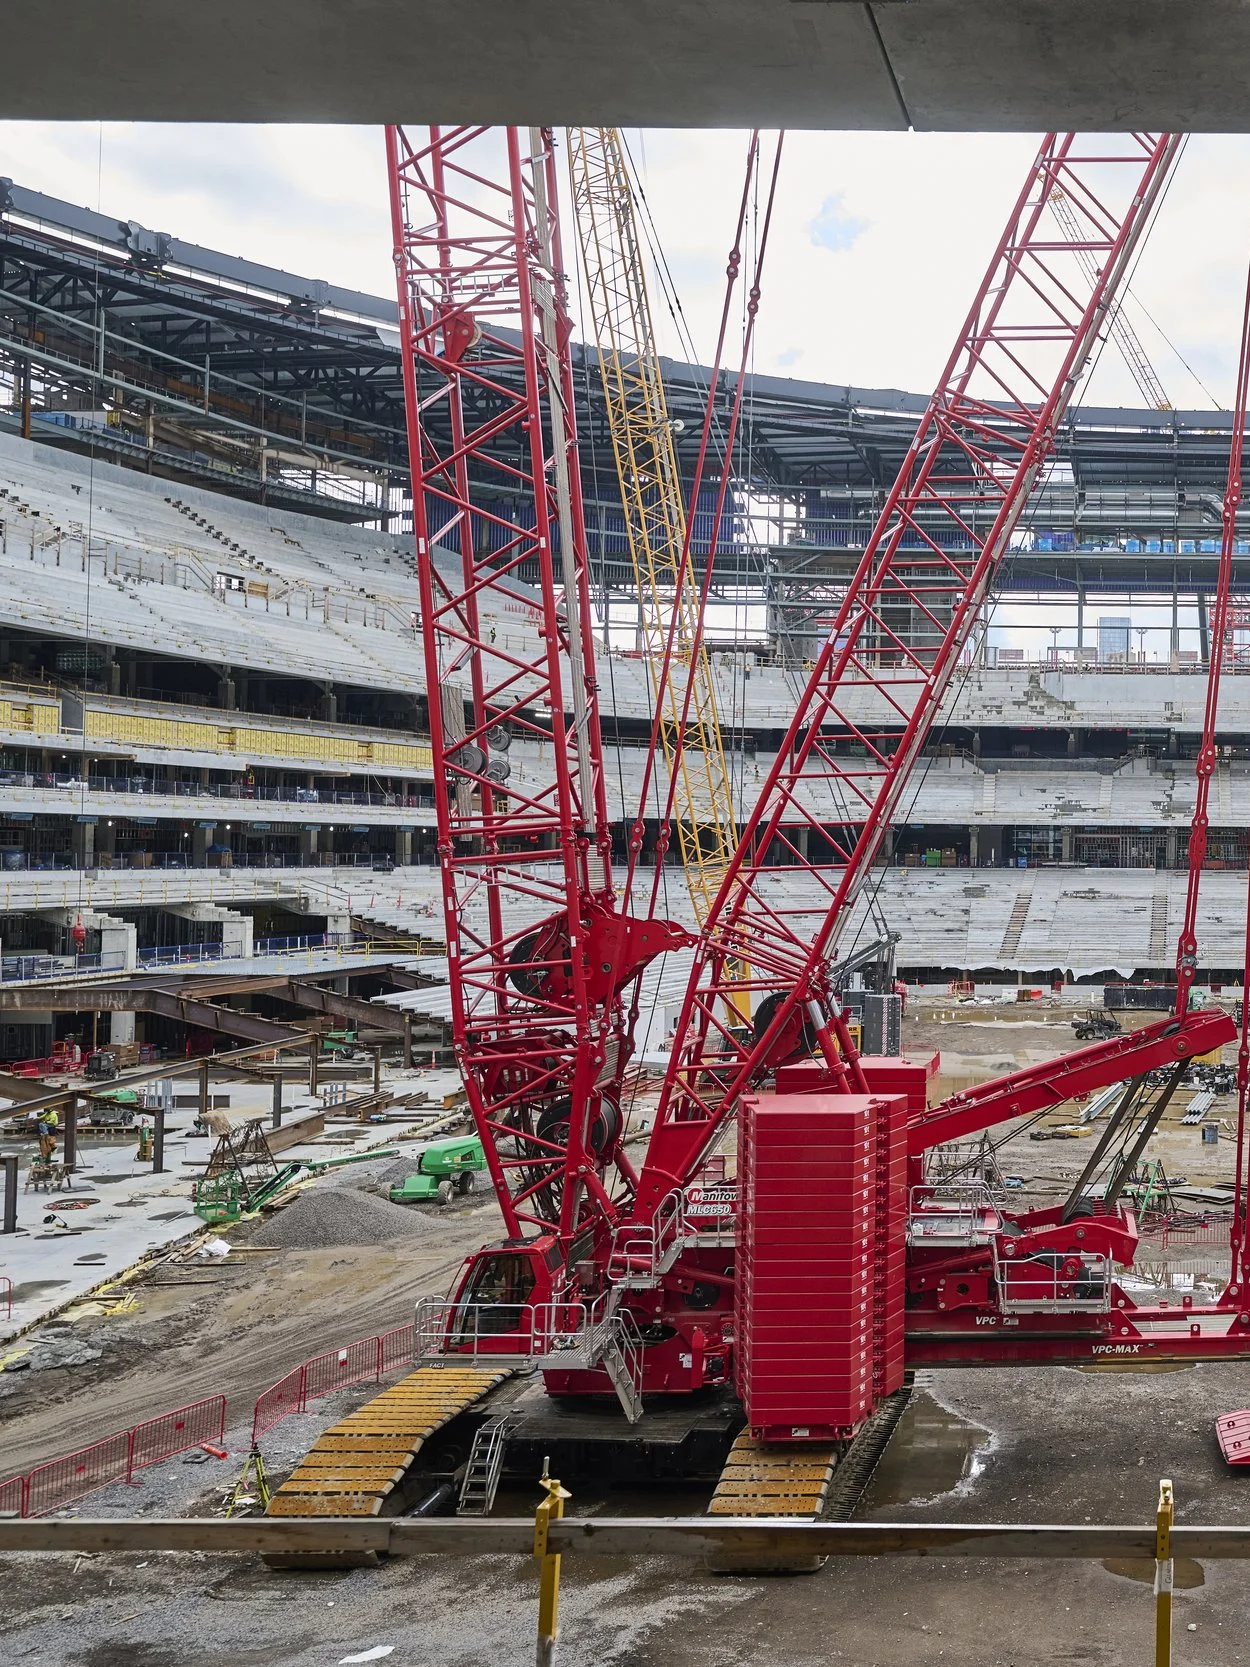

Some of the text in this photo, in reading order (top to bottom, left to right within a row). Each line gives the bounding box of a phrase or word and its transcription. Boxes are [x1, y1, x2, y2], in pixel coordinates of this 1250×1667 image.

[689, 1190, 738, 1202] Manitow
[688, 1204, 731, 1214] MLC650
[975, 1316, 998, 1325] VPC
[1092, 1344, 1141, 1354] VPC-MAX
